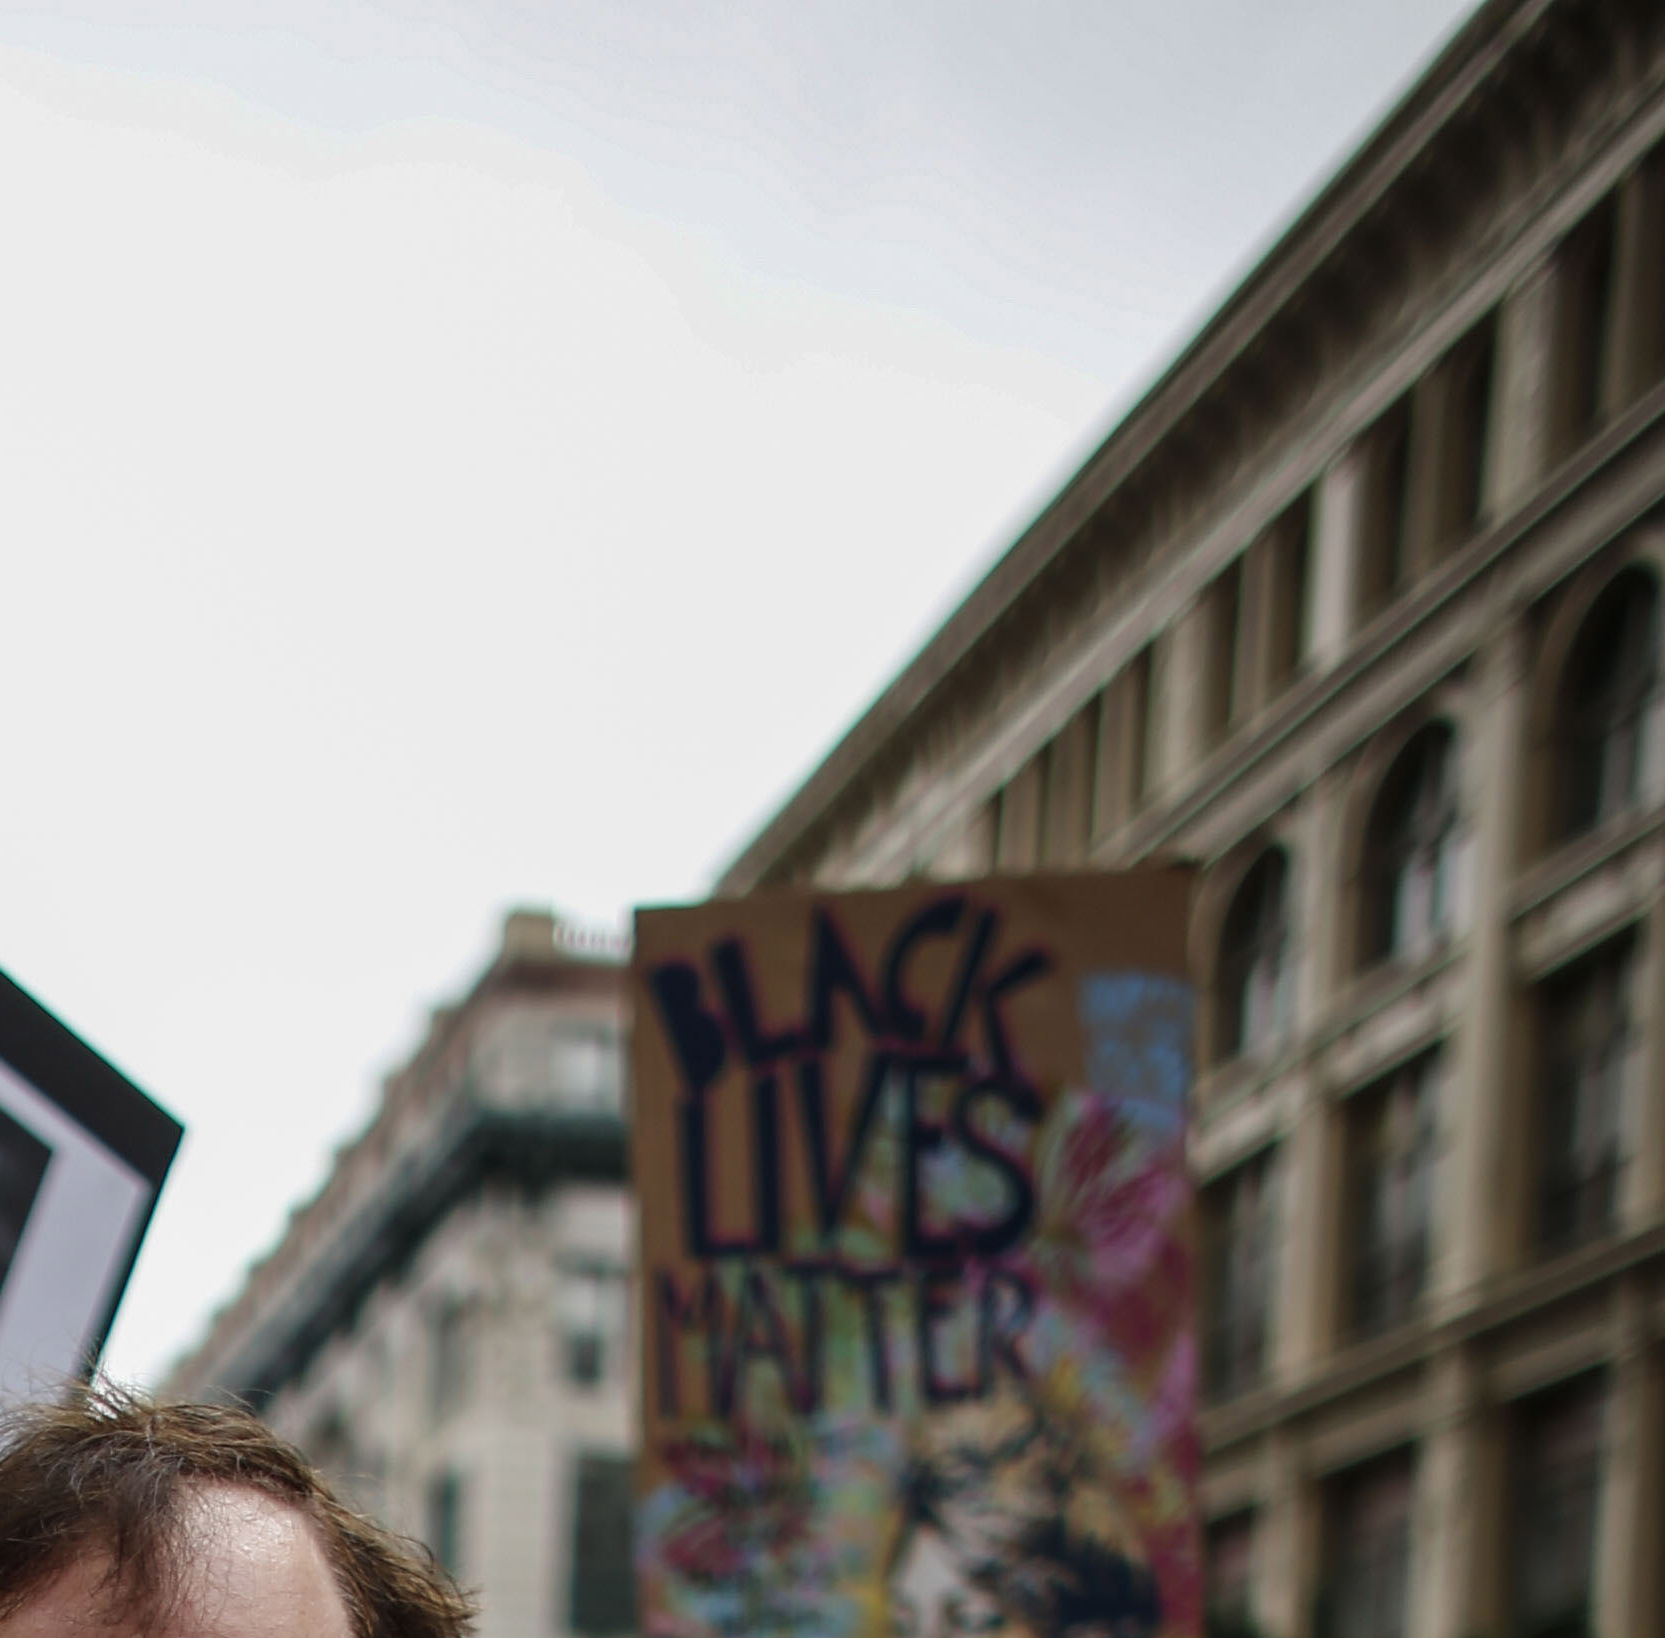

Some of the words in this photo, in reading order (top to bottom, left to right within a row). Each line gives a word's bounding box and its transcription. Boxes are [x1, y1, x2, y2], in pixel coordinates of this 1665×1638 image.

[646, 895, 1050, 1105] BLACK
[679, 1050, 1036, 1262] LIVES
[652, 1258, 1034, 1418] MATTER
